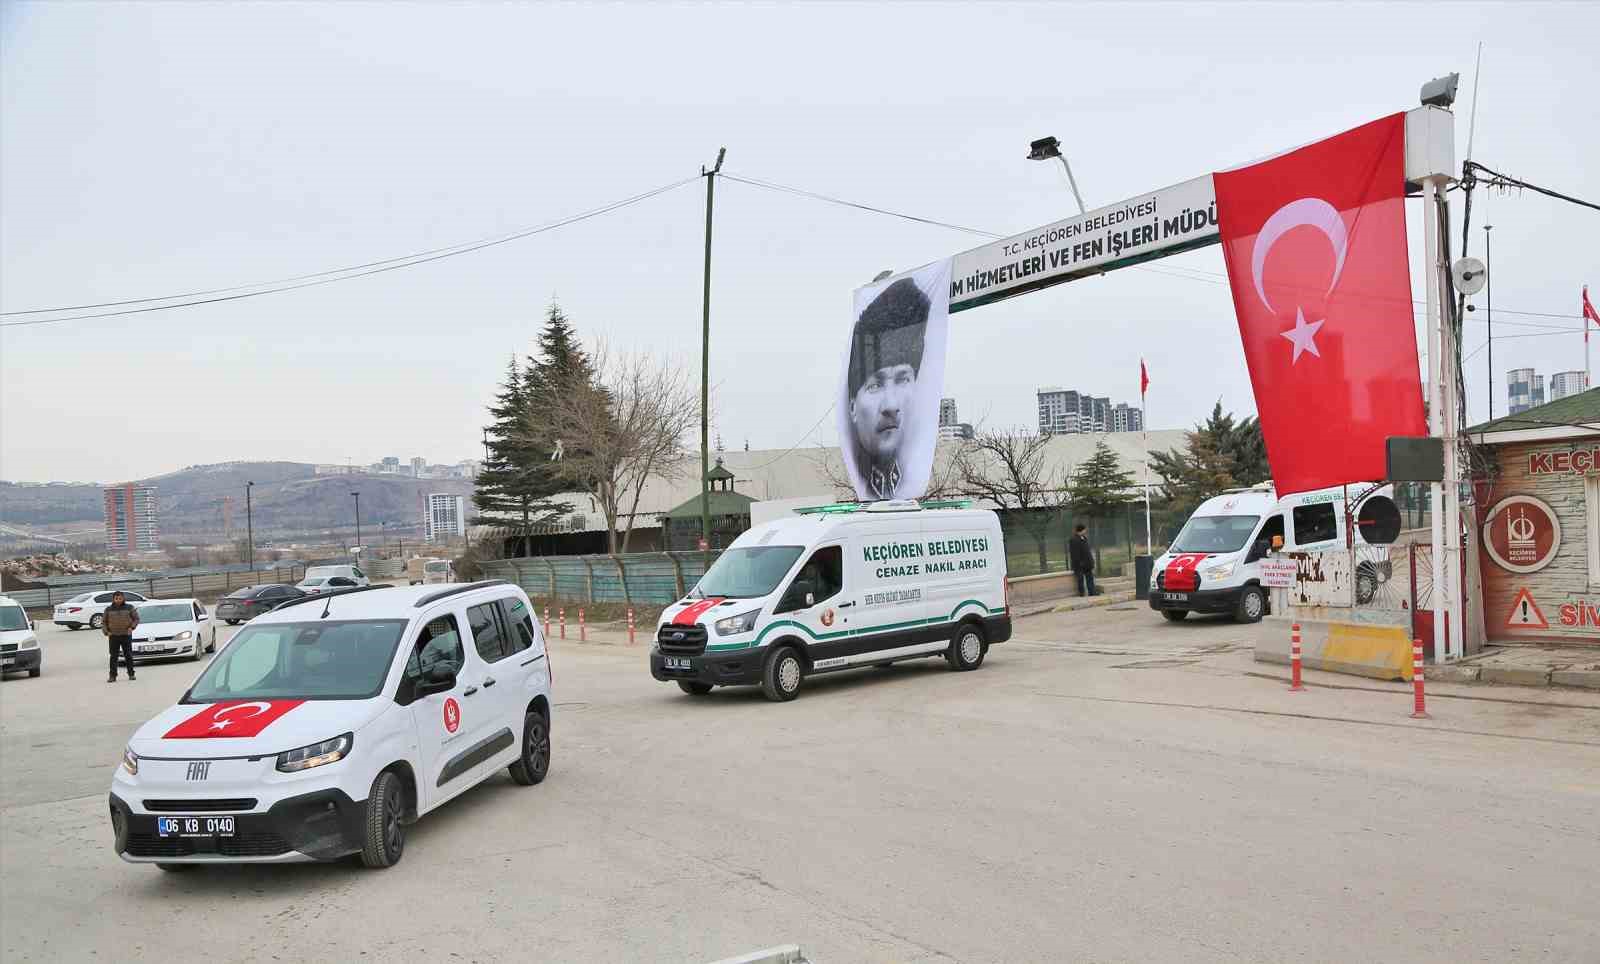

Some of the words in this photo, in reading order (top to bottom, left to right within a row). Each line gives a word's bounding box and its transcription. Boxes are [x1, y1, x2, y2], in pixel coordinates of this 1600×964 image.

[1002, 242, 1022, 257] T.C.
[1085, 197, 1157, 233] BELEDİYESİ
[966, 249, 1046, 293] HİZMETLERİ
[1050, 247, 1069, 269] VE
[1073, 238, 1104, 263] FEN
[1107, 217, 1159, 256] İŞLERİ
[863, 542, 923, 564] KEÇİÖREN
[876, 565, 920, 578] CENAZE
[959, 558, 987, 570] ARACI
[186, 761, 212, 781] FIAT
[165, 818, 179, 833] 06
[185, 818, 199, 833] KB
[207, 818, 233, 833] 0140
